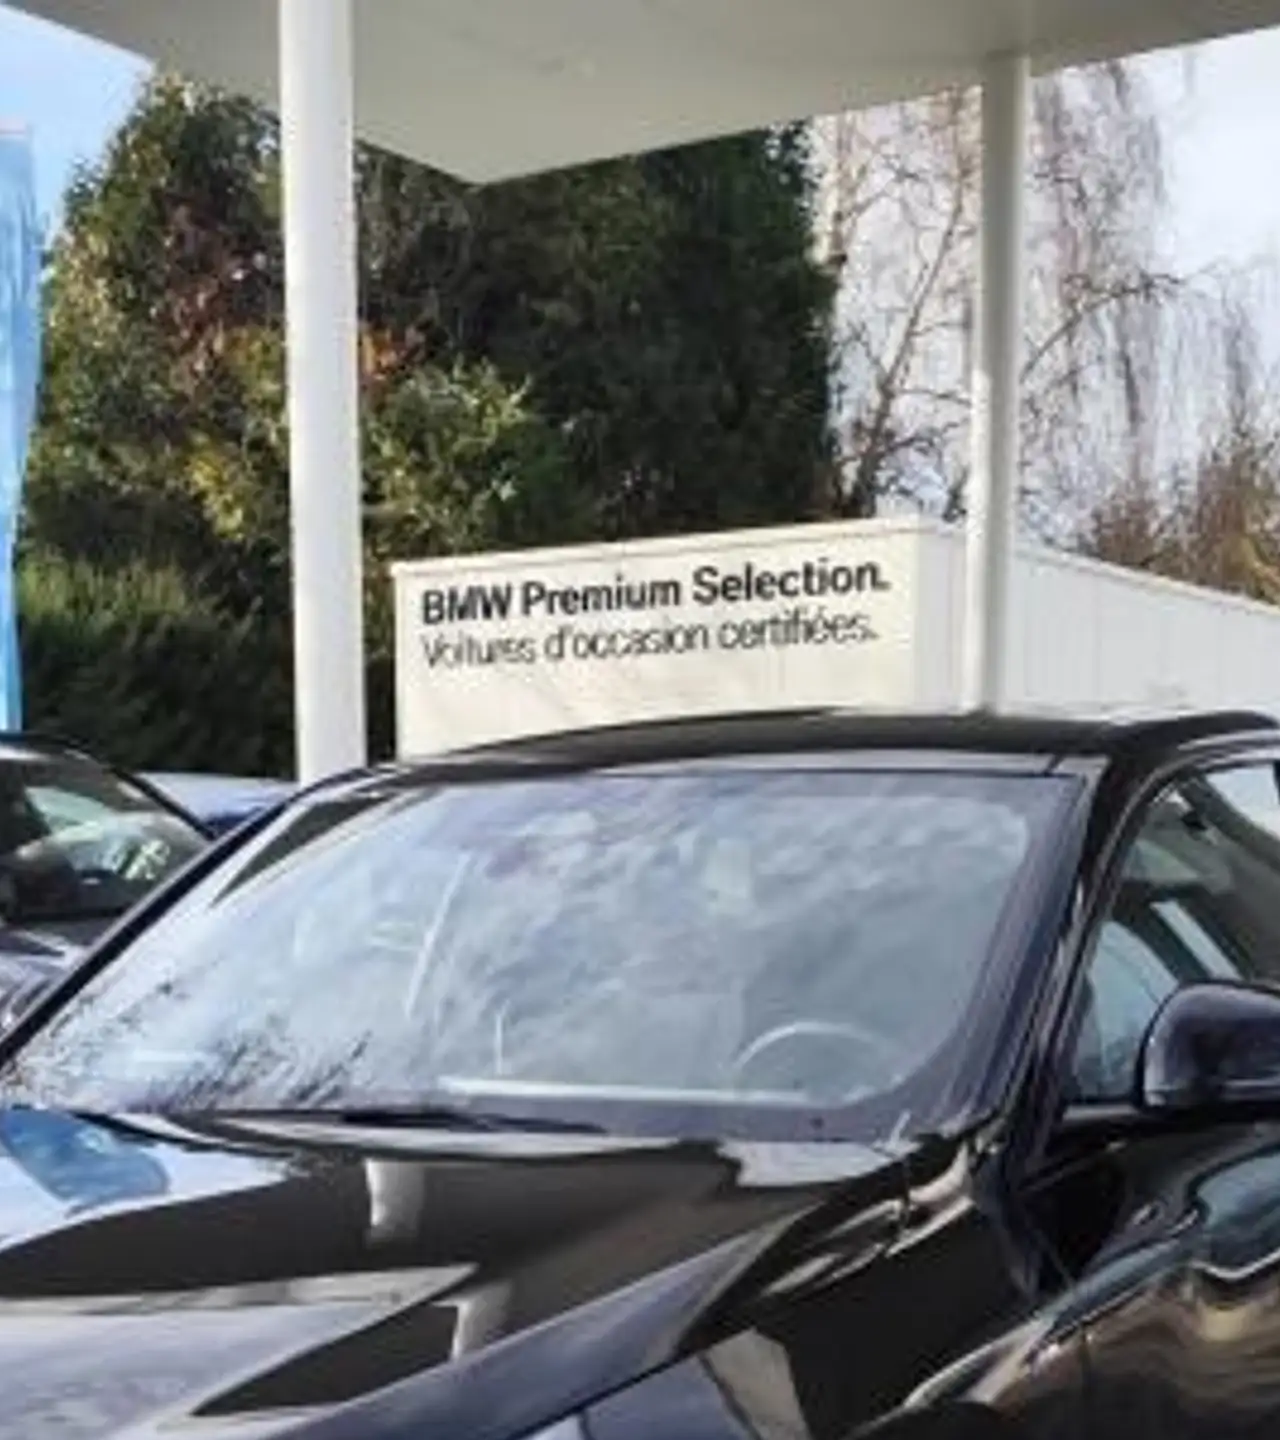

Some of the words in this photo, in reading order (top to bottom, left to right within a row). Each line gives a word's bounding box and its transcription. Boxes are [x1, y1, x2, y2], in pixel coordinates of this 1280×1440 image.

[422, 582, 512, 626] BMW
[521, 572, 681, 618] Premium
[692, 556, 892, 605] Selection.
[421, 629, 536, 670] Voitures
[544, 618, 710, 661] d'occasion
